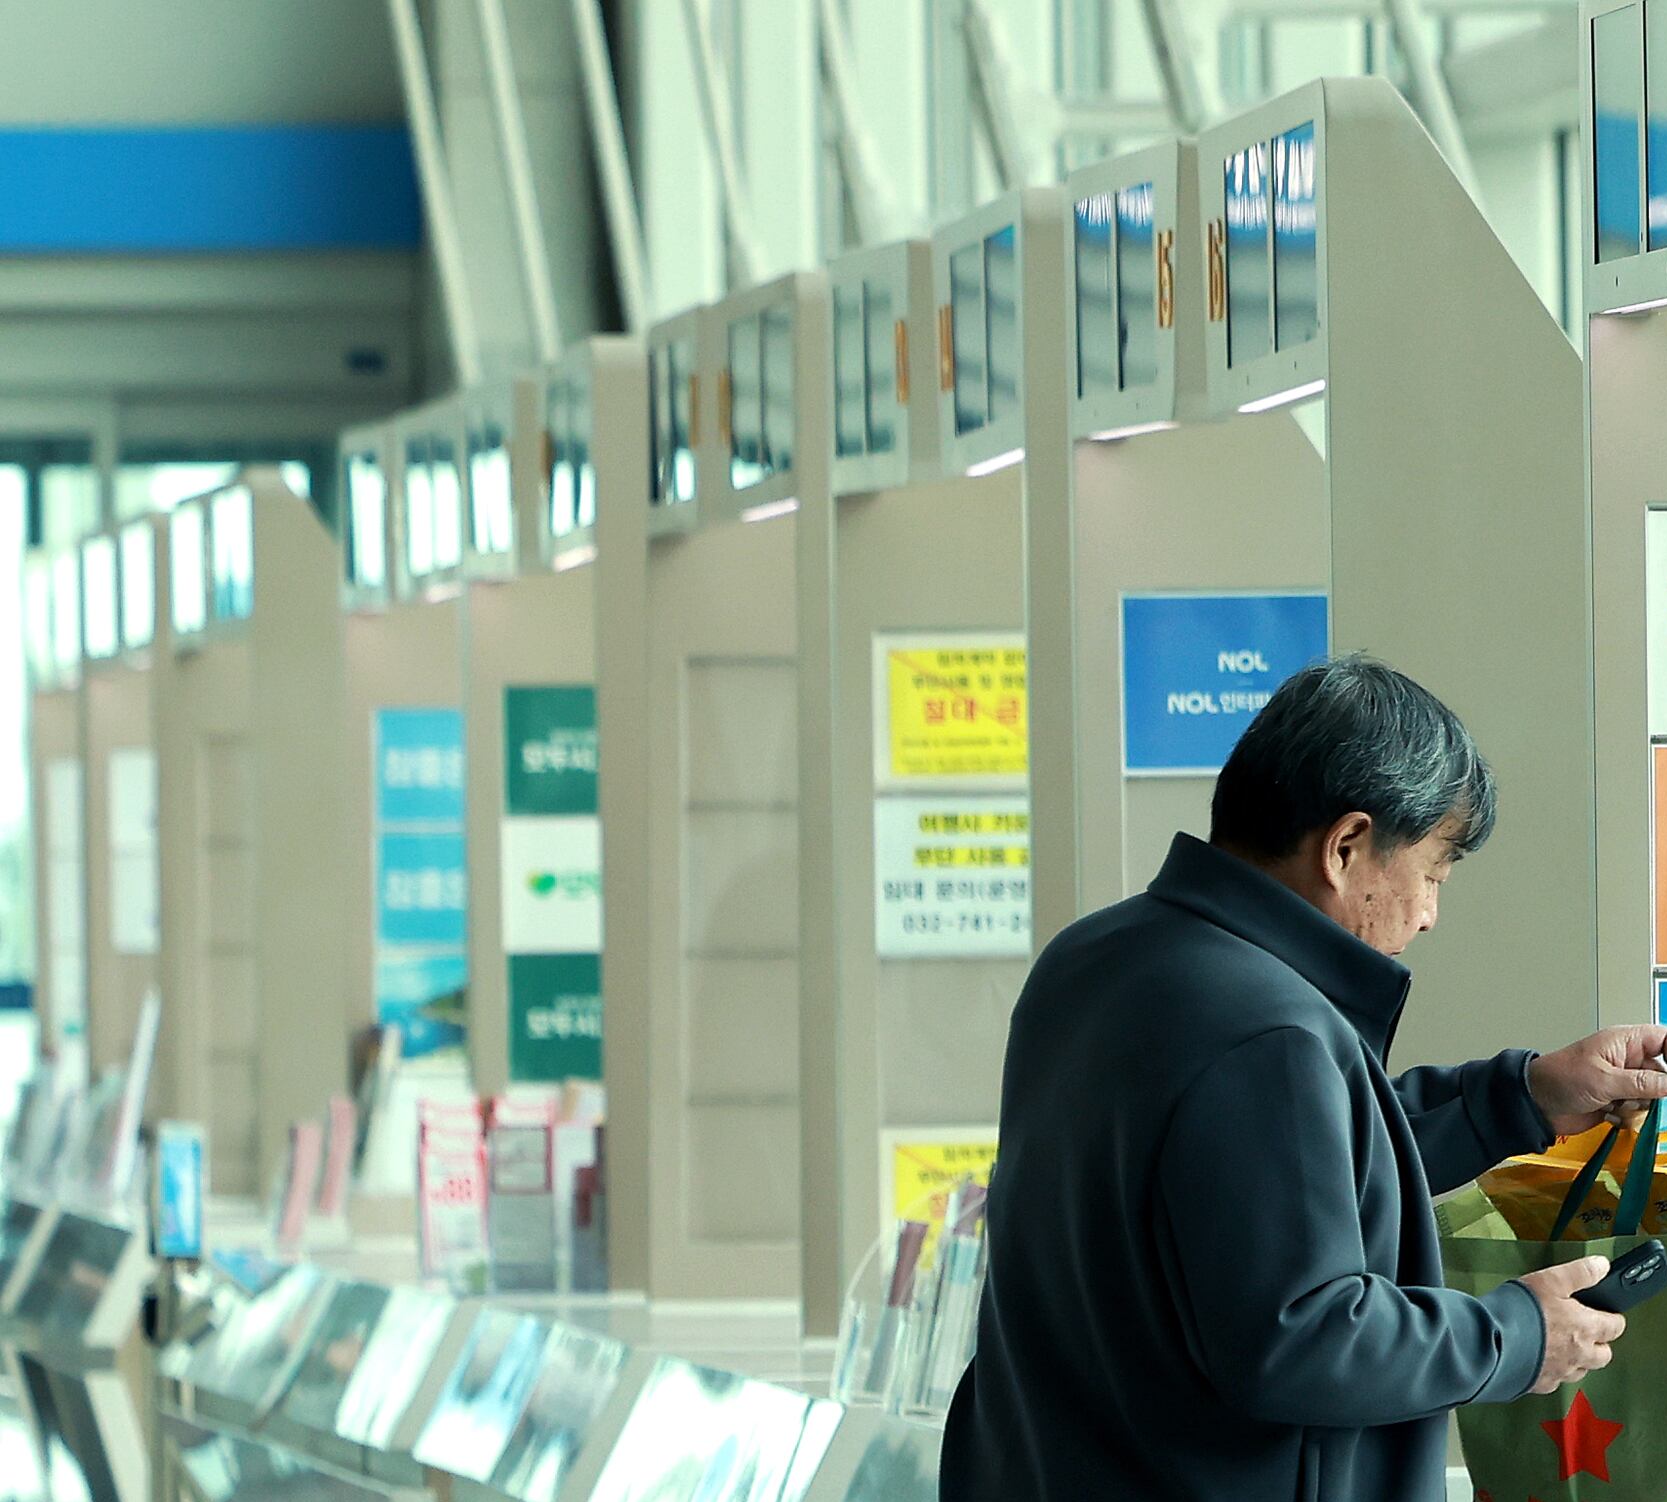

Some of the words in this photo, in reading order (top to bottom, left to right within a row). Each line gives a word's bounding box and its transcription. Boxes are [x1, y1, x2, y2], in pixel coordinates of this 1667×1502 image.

[1207, 217, 1225, 322] 16
[1217, 650, 1270, 673] NOL
[1166, 691, 1219, 715] NOL
